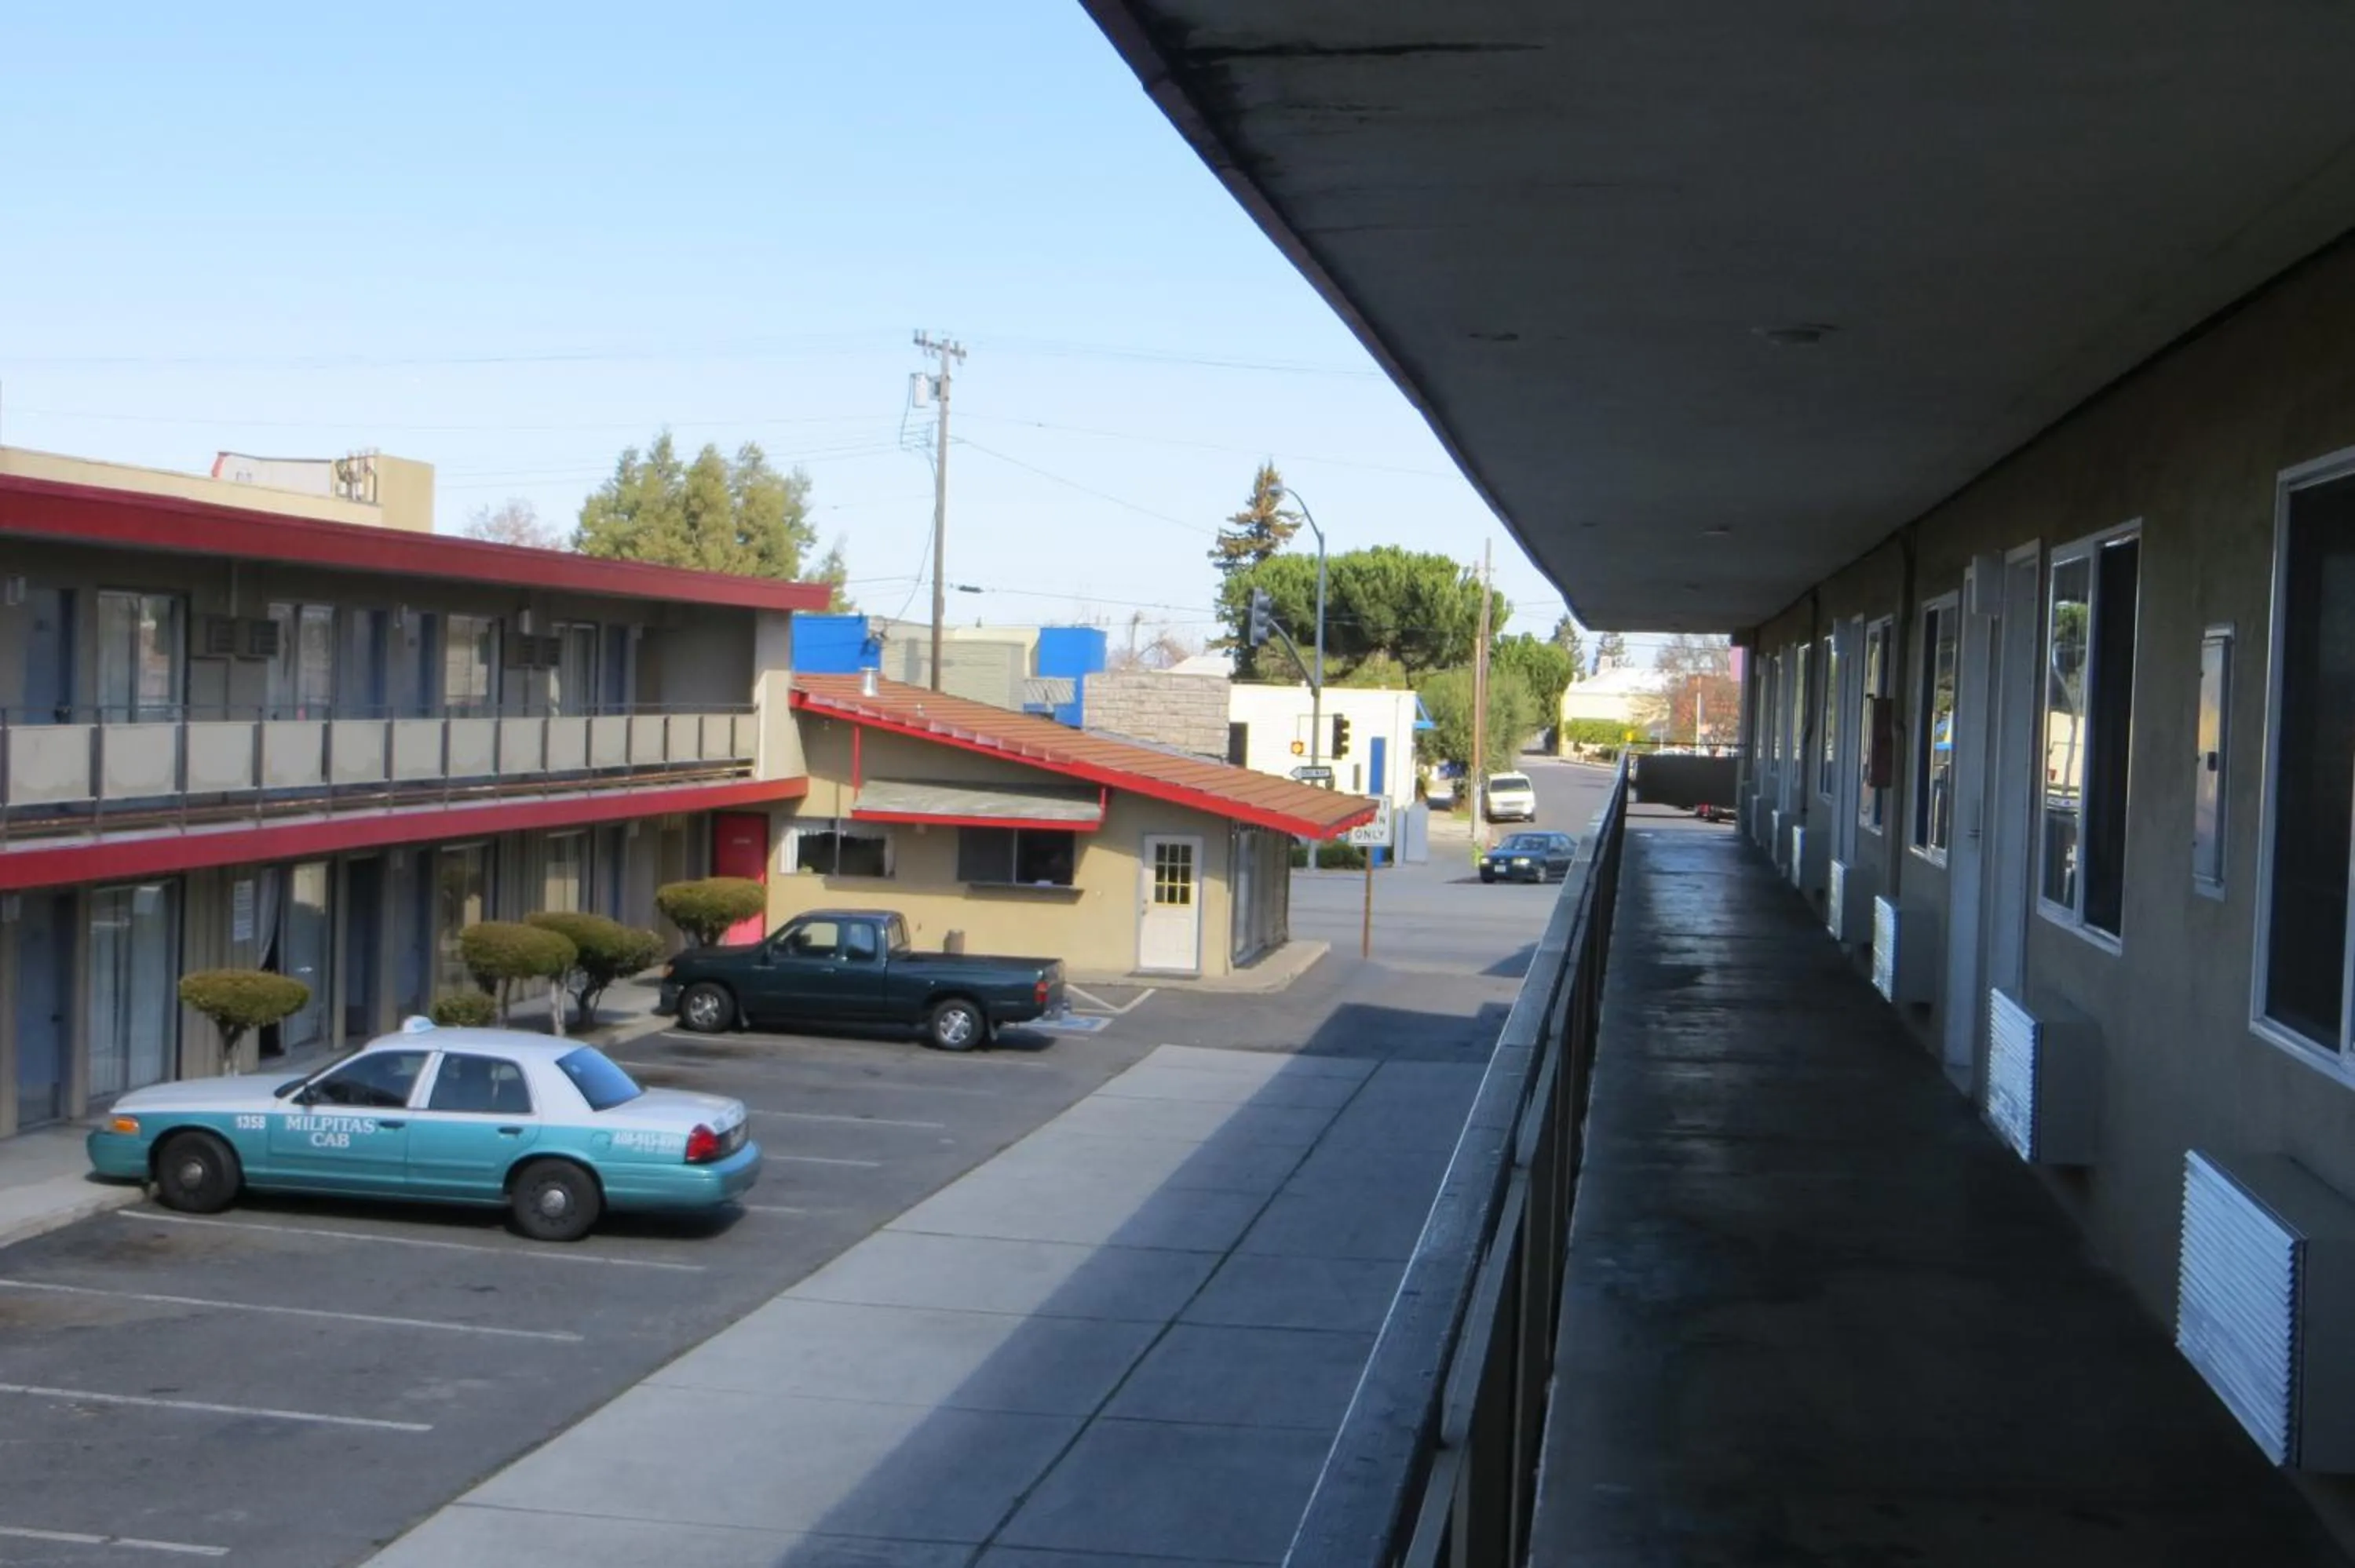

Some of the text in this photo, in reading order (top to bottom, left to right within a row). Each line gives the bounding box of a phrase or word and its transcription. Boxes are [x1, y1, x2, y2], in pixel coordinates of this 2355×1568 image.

[1354, 829, 1384, 840] ONLY
[286, 1115, 375, 1133] MILPITAS
[311, 1132, 350, 1147] CAB
